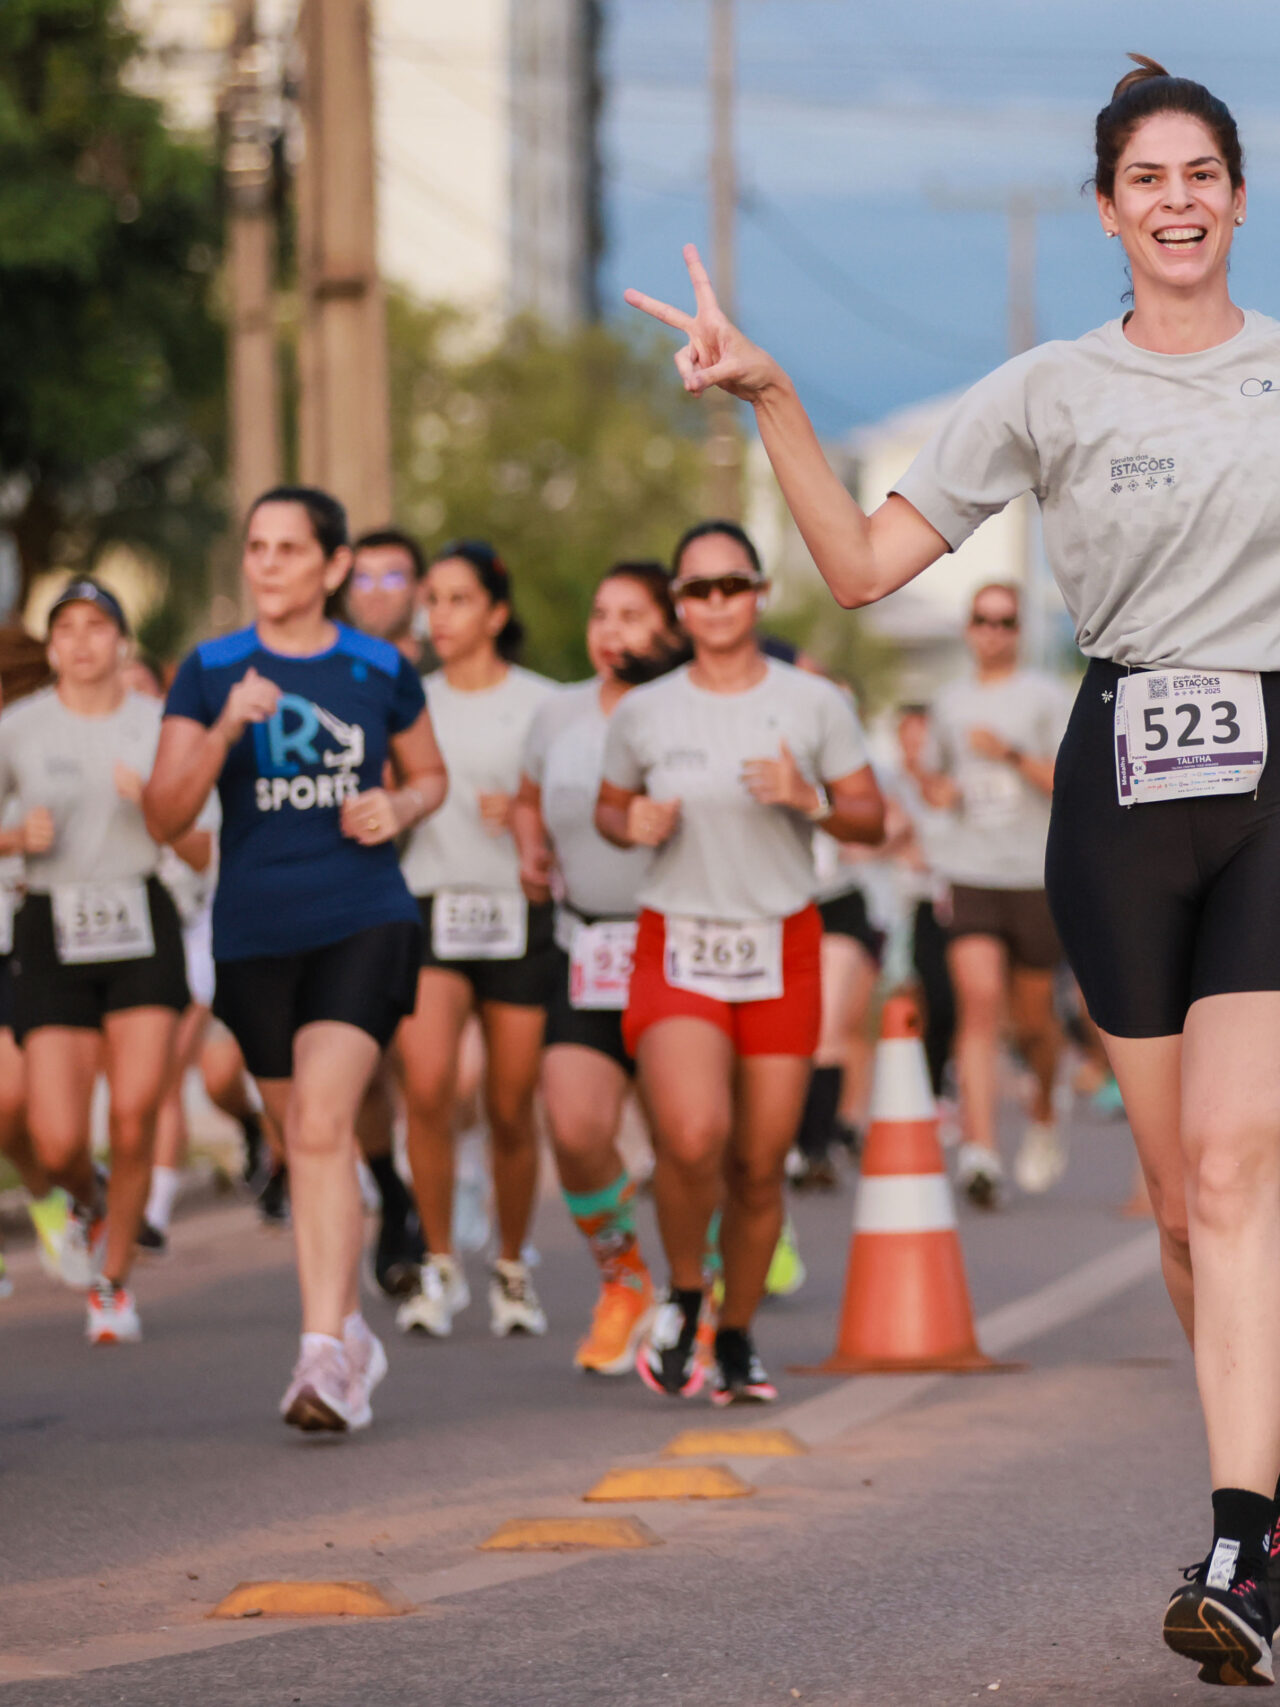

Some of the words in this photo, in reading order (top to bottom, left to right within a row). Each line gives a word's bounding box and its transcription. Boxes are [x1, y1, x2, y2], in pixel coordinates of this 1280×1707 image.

[1110, 456, 1134, 465] Circuito
[1111, 457, 1175, 478] ESTAÇÕES
[1173, 677, 1220, 688] ESTAÇÕES
[1143, 701, 1241, 751] 523
[1176, 755, 1212, 765] TALITHA
[691, 935, 756, 966] 269
